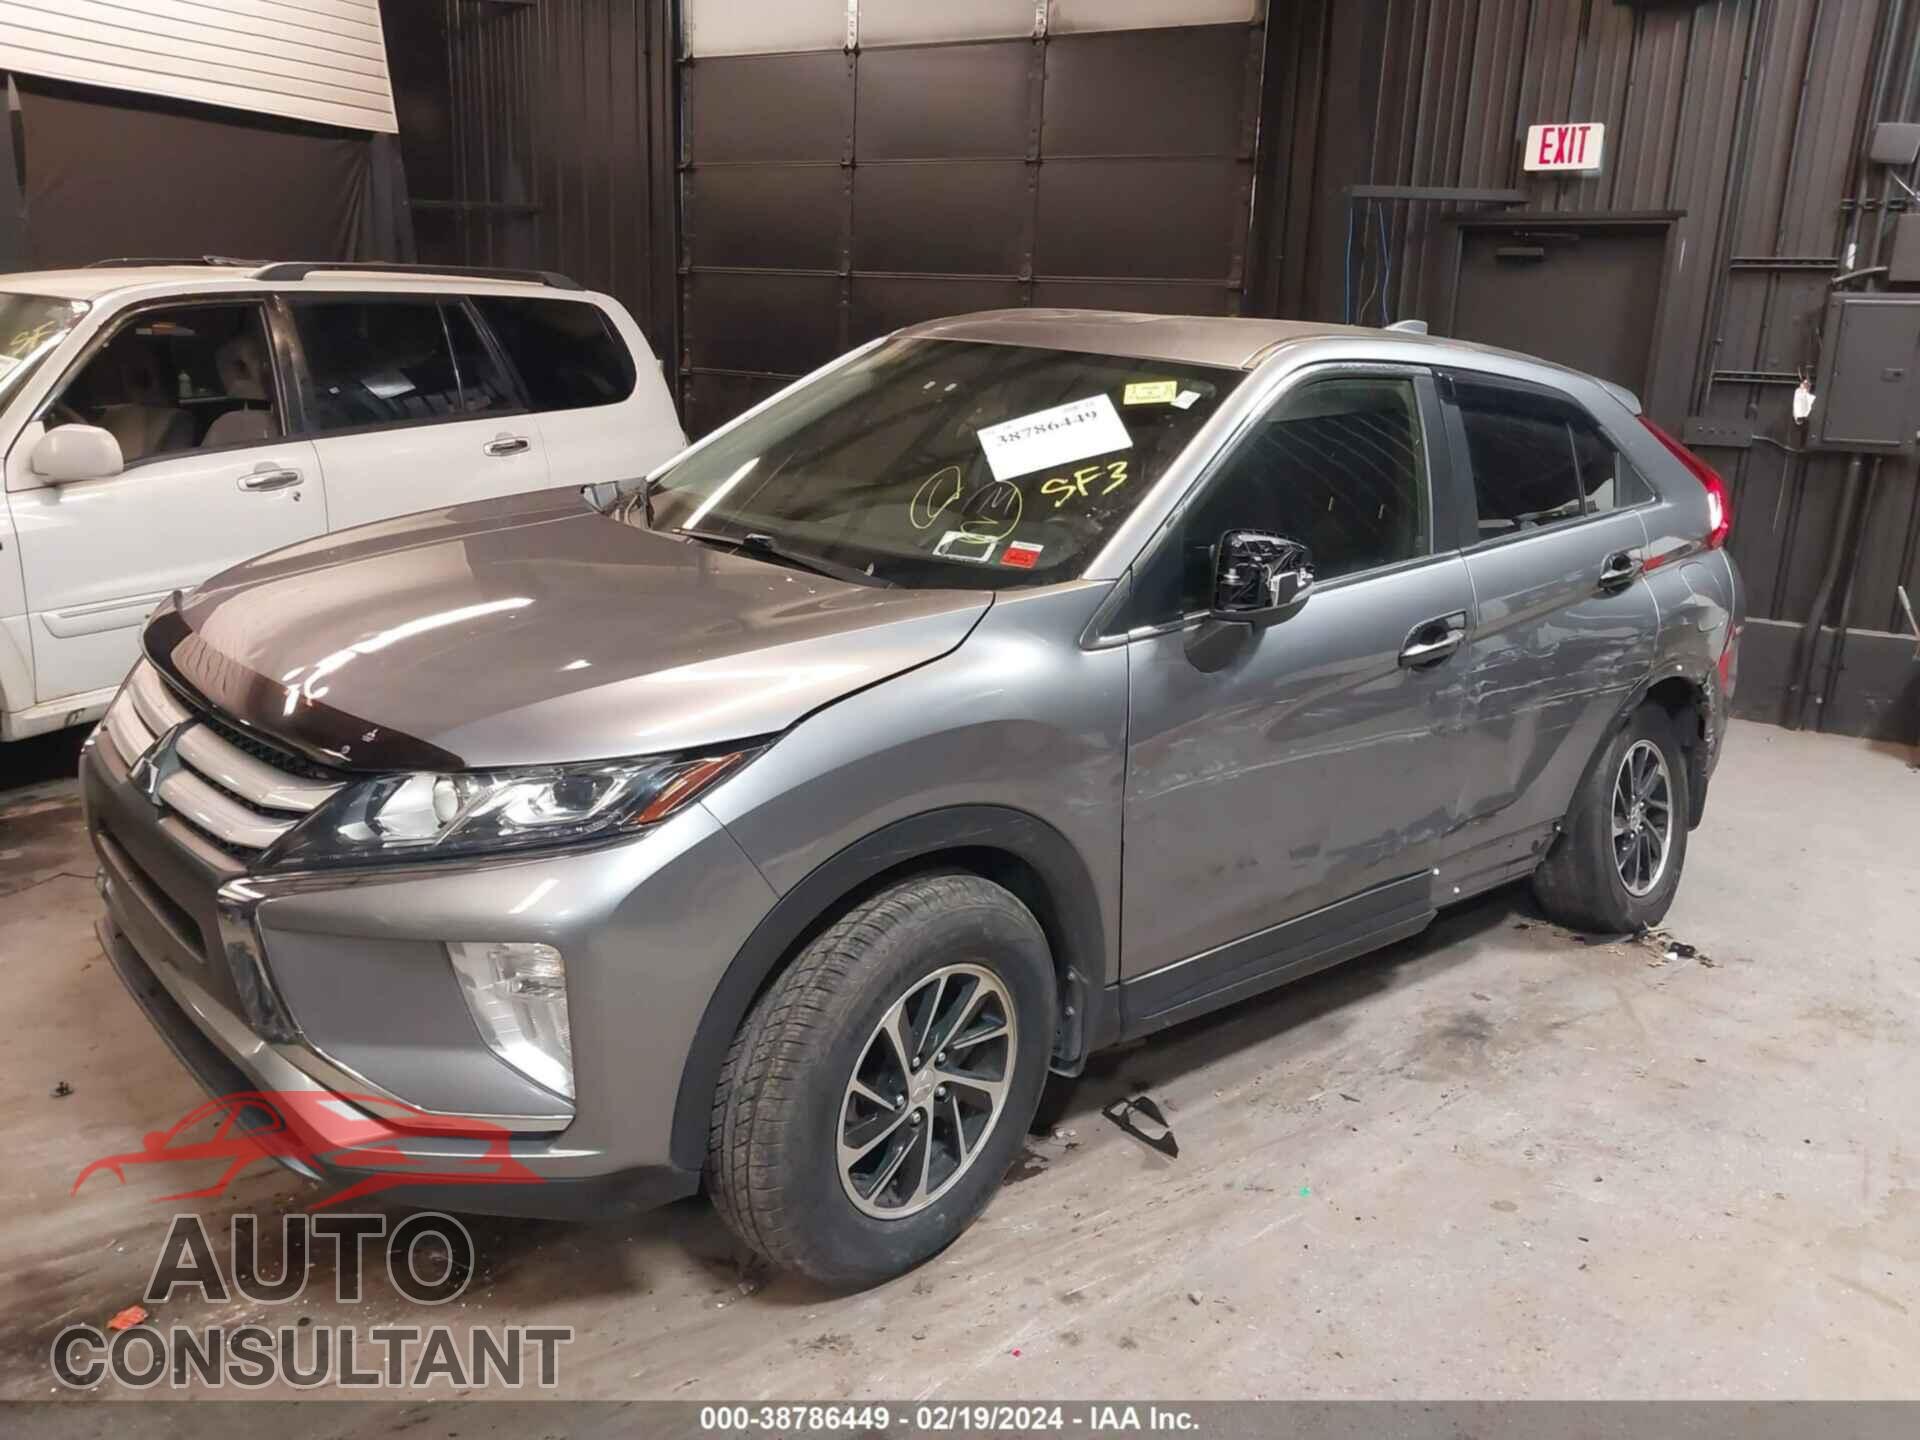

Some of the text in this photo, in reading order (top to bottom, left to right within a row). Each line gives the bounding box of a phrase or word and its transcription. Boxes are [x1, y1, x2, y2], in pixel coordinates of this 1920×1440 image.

[1538, 126, 1591, 164] EXIT
[998, 410, 1097, 447] 38786449
[1041, 461, 1128, 508] SF3
